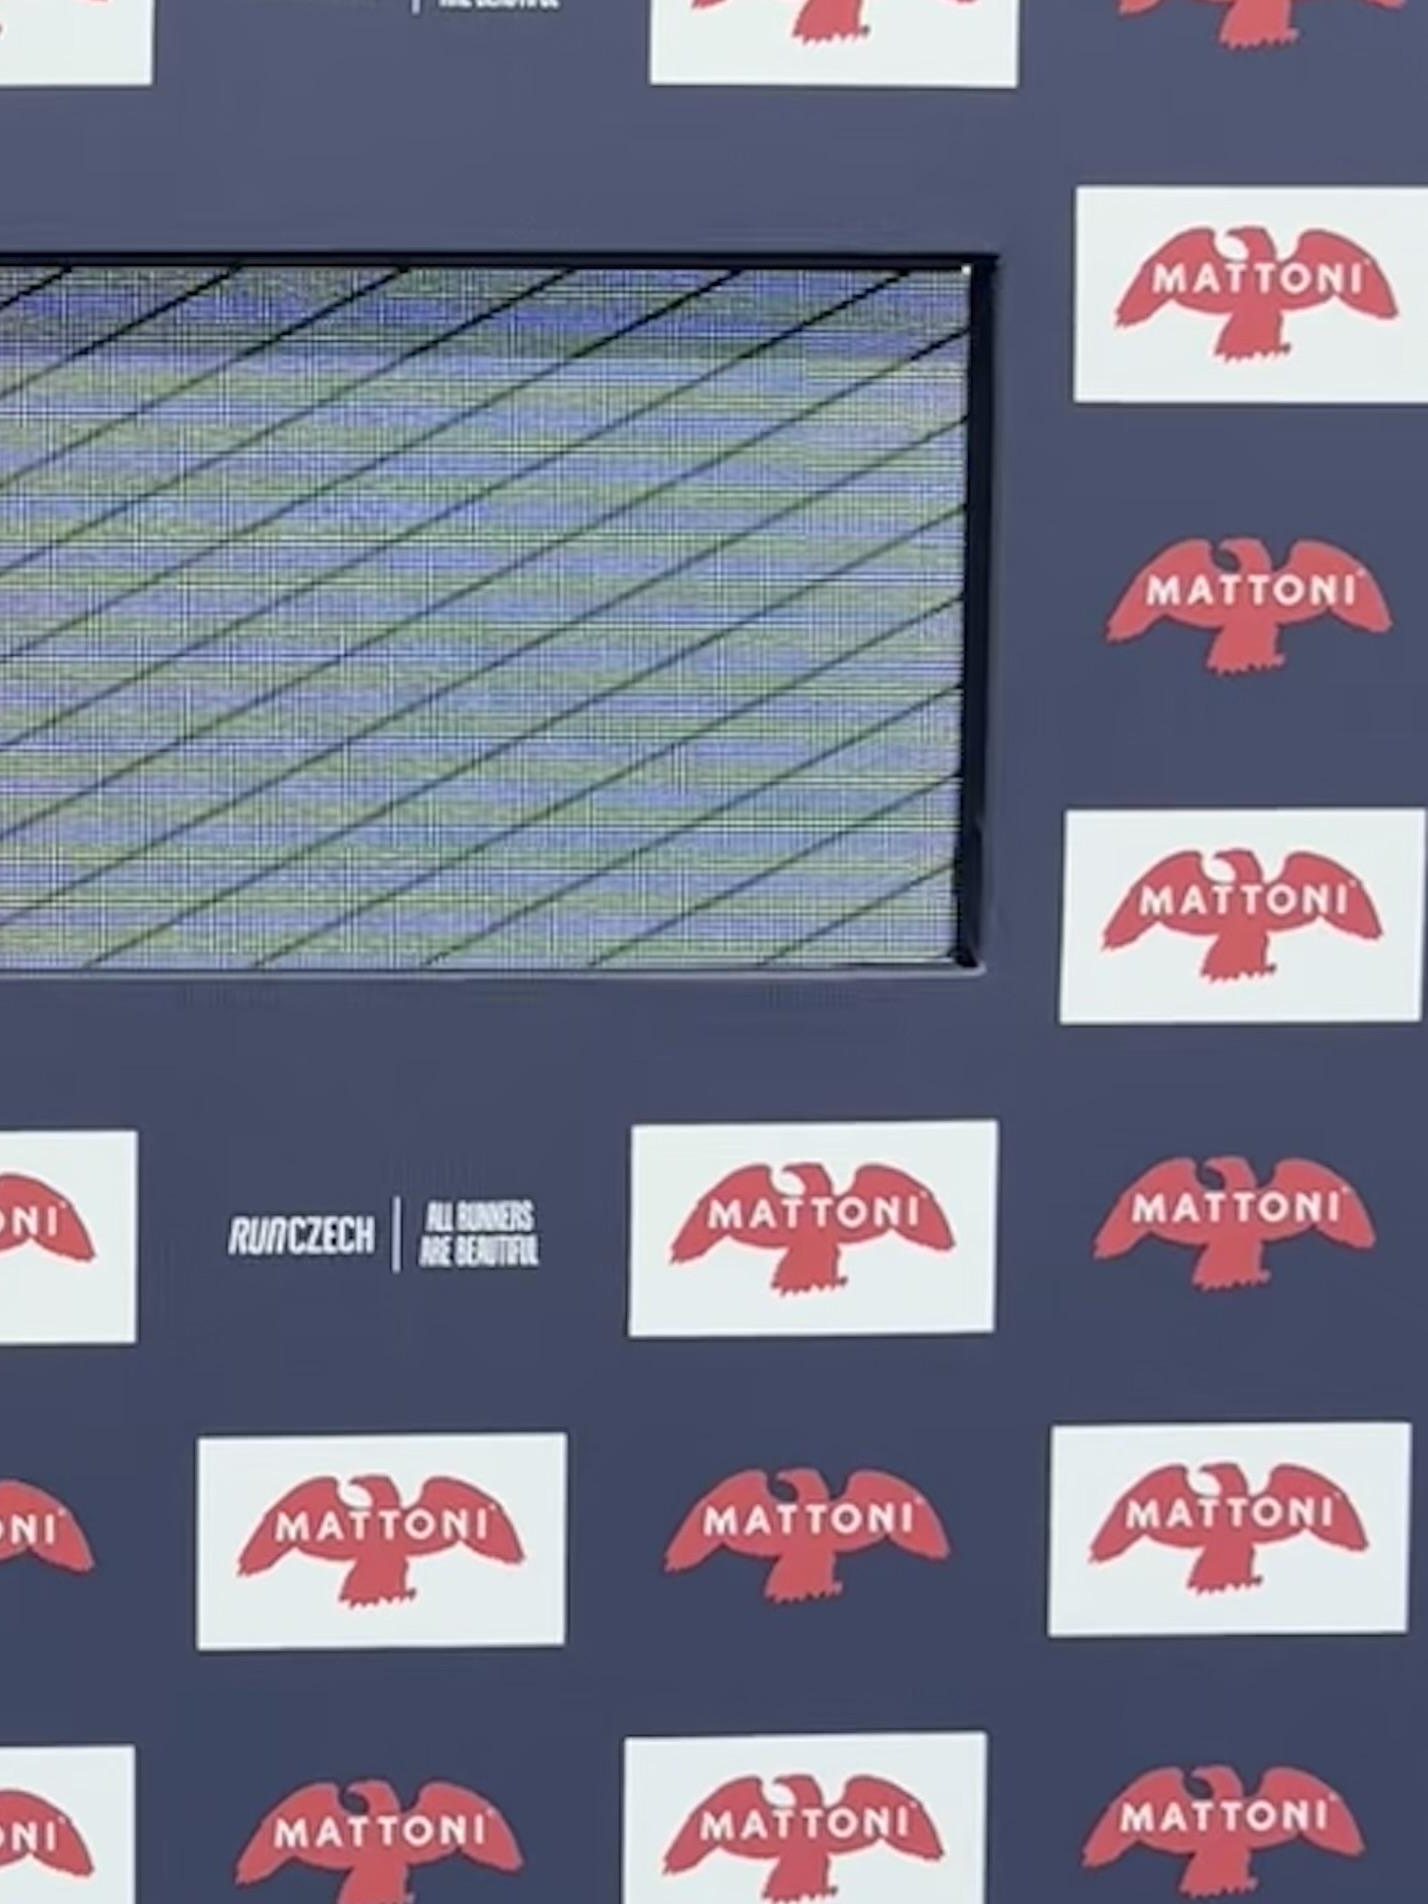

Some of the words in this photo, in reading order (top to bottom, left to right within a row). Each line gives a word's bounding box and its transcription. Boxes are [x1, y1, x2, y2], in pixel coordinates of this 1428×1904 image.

[1152, 262, 1361, 294] MATTONI
[1146, 574, 1355, 606] MATTONI
[1139, 883, 1347, 916] MATTONI
[425, 1200, 454, 1232] ALL
[456, 1199, 535, 1232] RUNNERS
[708, 1196, 918, 1229] MATTONI
[1132, 1191, 1339, 1223] MATTONI
[227, 1214, 375, 1256] RUNCZECH
[418, 1234, 453, 1267] ARE
[455, 1234, 540, 1267] BEAUTIFUL
[275, 1508, 487, 1542] MATTONI
[704, 1503, 912, 1536] MATTONI
[1126, 1496, 1332, 1529] MATTONI
[274, 1814, 484, 1848] MATTONI
[700, 1806, 907, 1840] MATTONI
[1120, 1800, 1326, 1832] MATTONI
